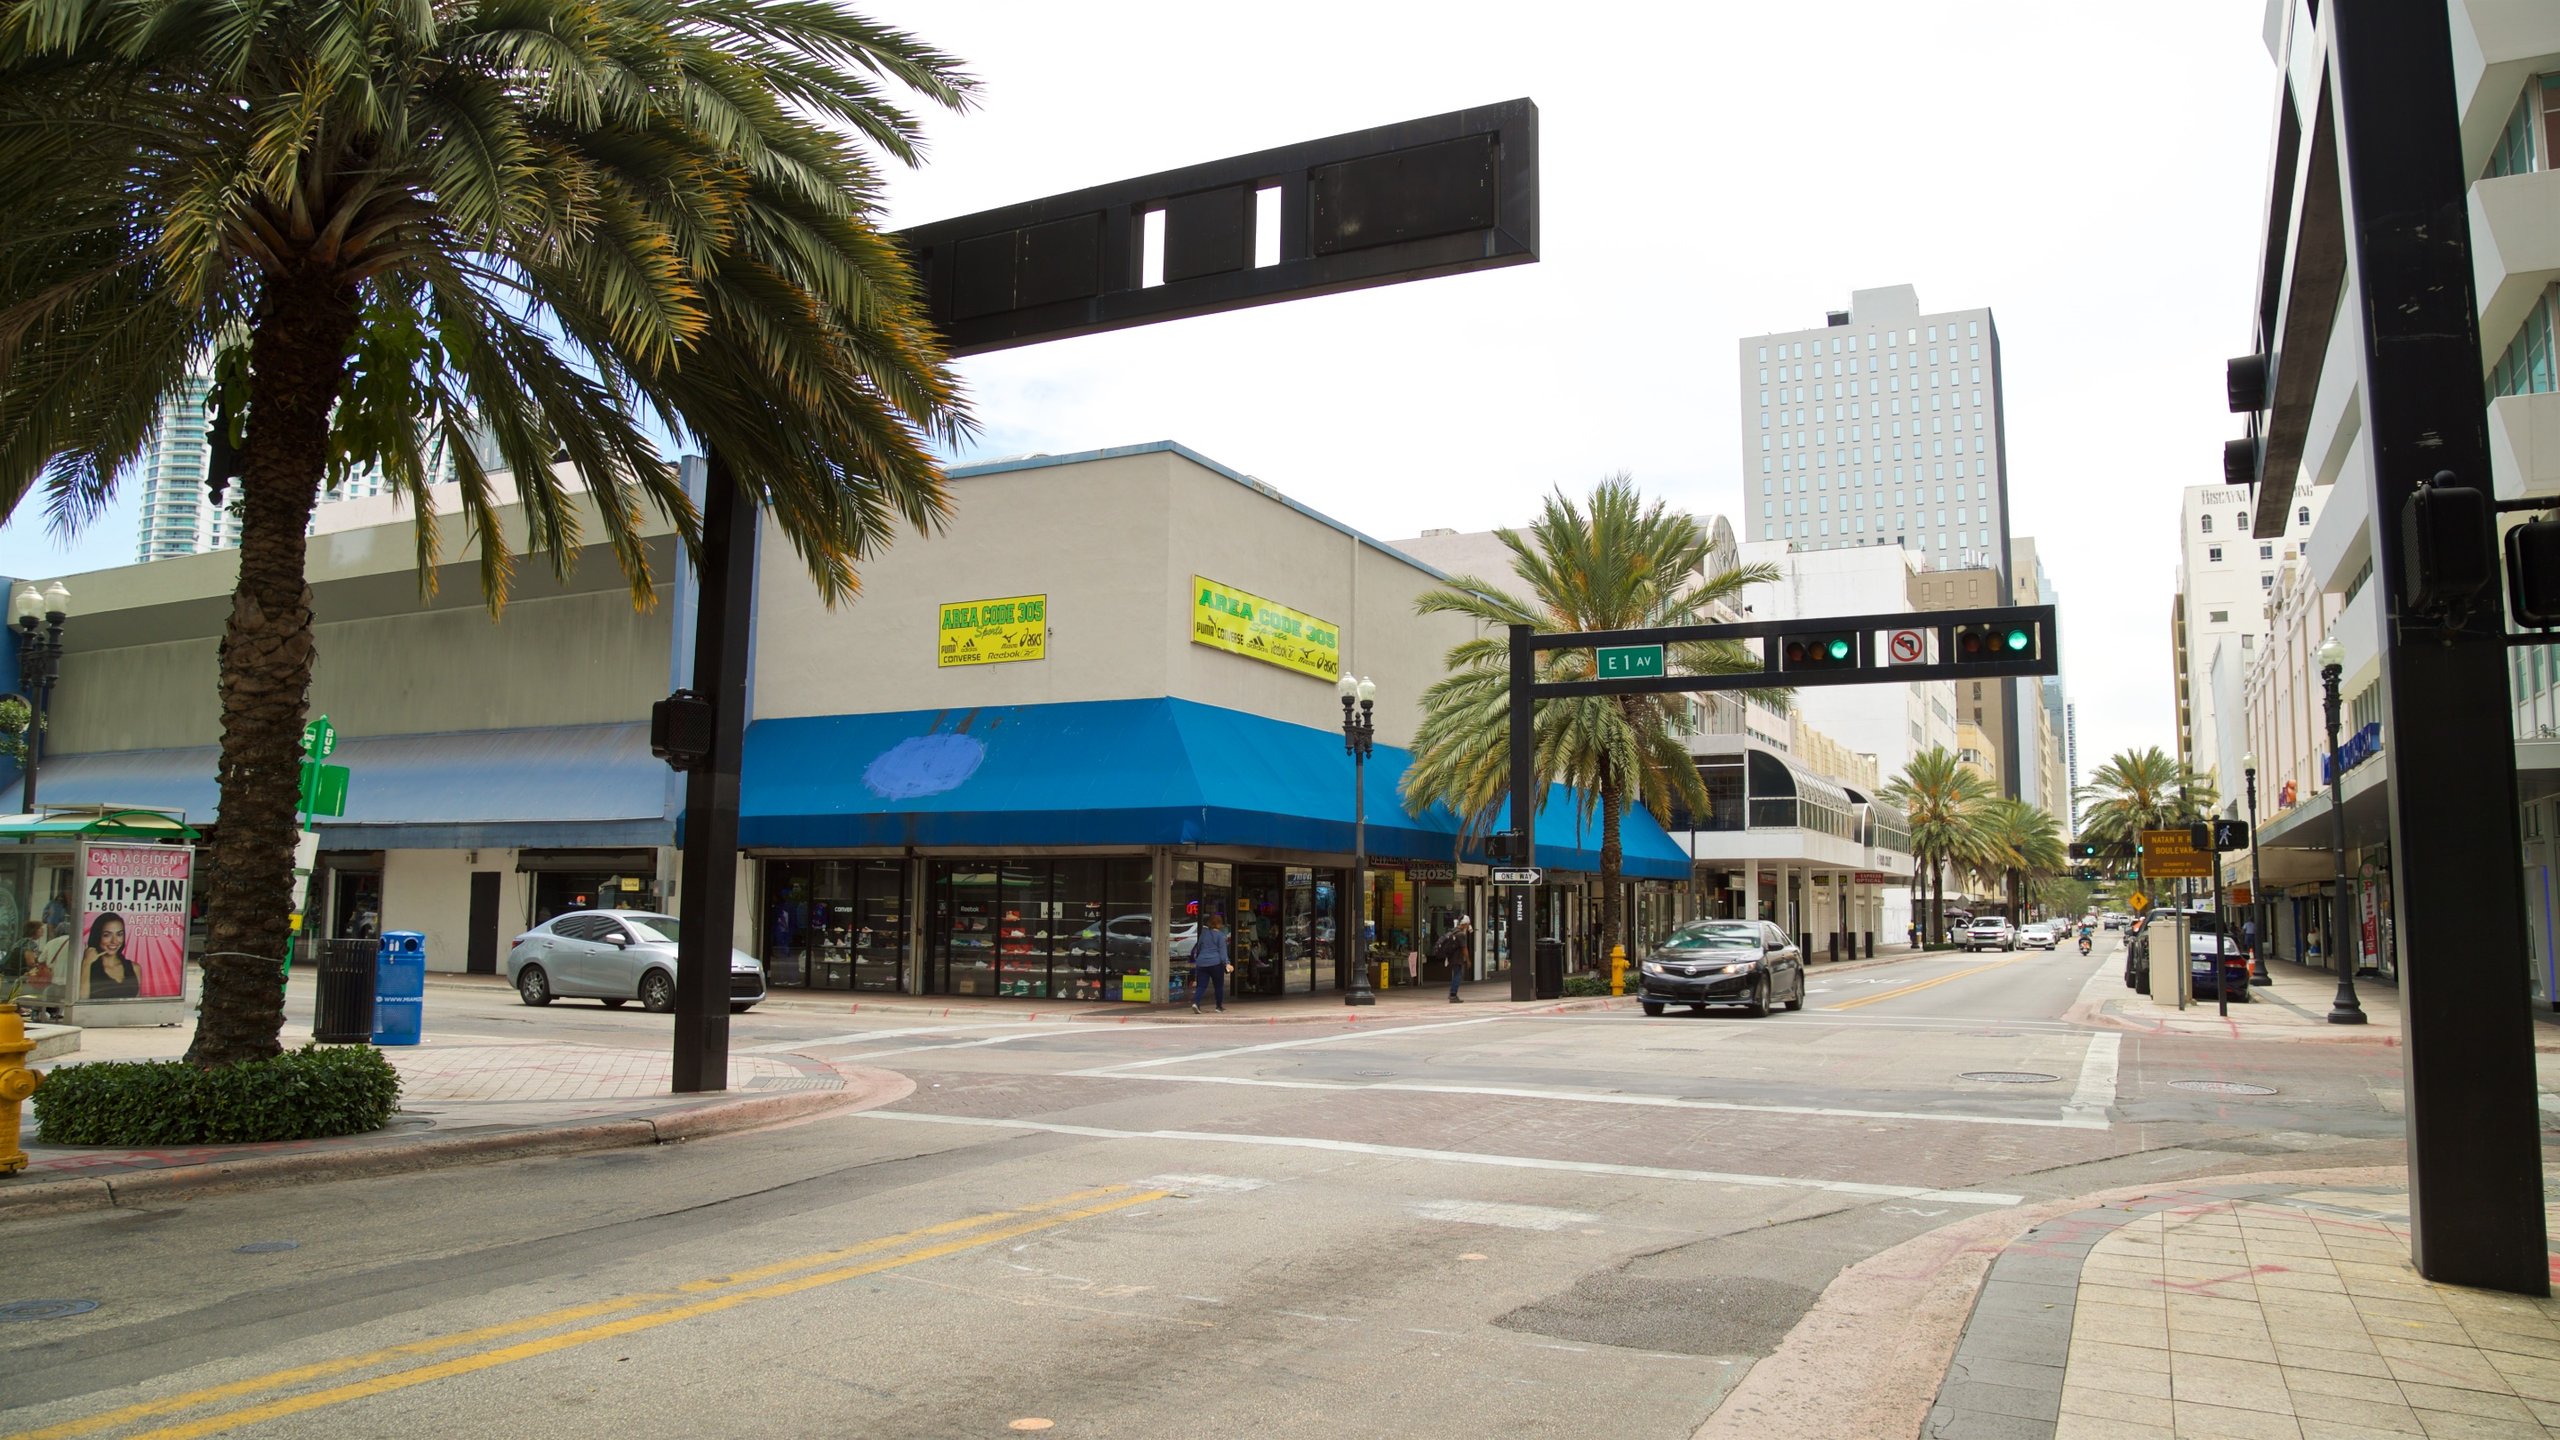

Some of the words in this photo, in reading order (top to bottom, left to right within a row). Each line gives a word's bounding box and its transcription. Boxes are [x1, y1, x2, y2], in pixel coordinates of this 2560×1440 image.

[942, 607, 979, 630] AREA
[982, 604, 1015, 626] CODE
[1018, 600, 1044, 623] 305
[1199, 589, 1255, 622] AREA
[1258, 608, 1302, 638] CODE
[1306, 625, 1336, 649] 305
[974, 624, 1004, 640] Sports
[1196, 621, 1215, 637] PUMA
[1217, 627, 1244, 646] CONVERSE
[941, 643, 956, 654] PUMA
[1246, 641, 1268, 654] adidas
[943, 653, 981, 664] CONVERSE
[988, 650, 1020, 660] Reebok
[1608, 656, 1617, 670] E
[1624, 655, 1630, 671] 1
[1637, 656, 1651, 667] AV
[323, 728, 334, 755] BUS
[2151, 836, 2175, 844] NATAN
[92, 852, 117, 863] CAR
[123, 854, 185, 866] ACCIDENT
[101, 865, 128, 875] SLIP
[133, 866, 143, 876] &
[145, 866, 174, 877] FALL
[1408, 869, 1454, 880] SHOES
[1519, 872, 1533, 880] WAY
[960, 905, 980, 913] Reebok
[128, 915, 160, 925] AFTER
[163, 916, 181, 925] 911
[134, 927, 159, 937] CALL
[163, 927, 181, 937] 411
